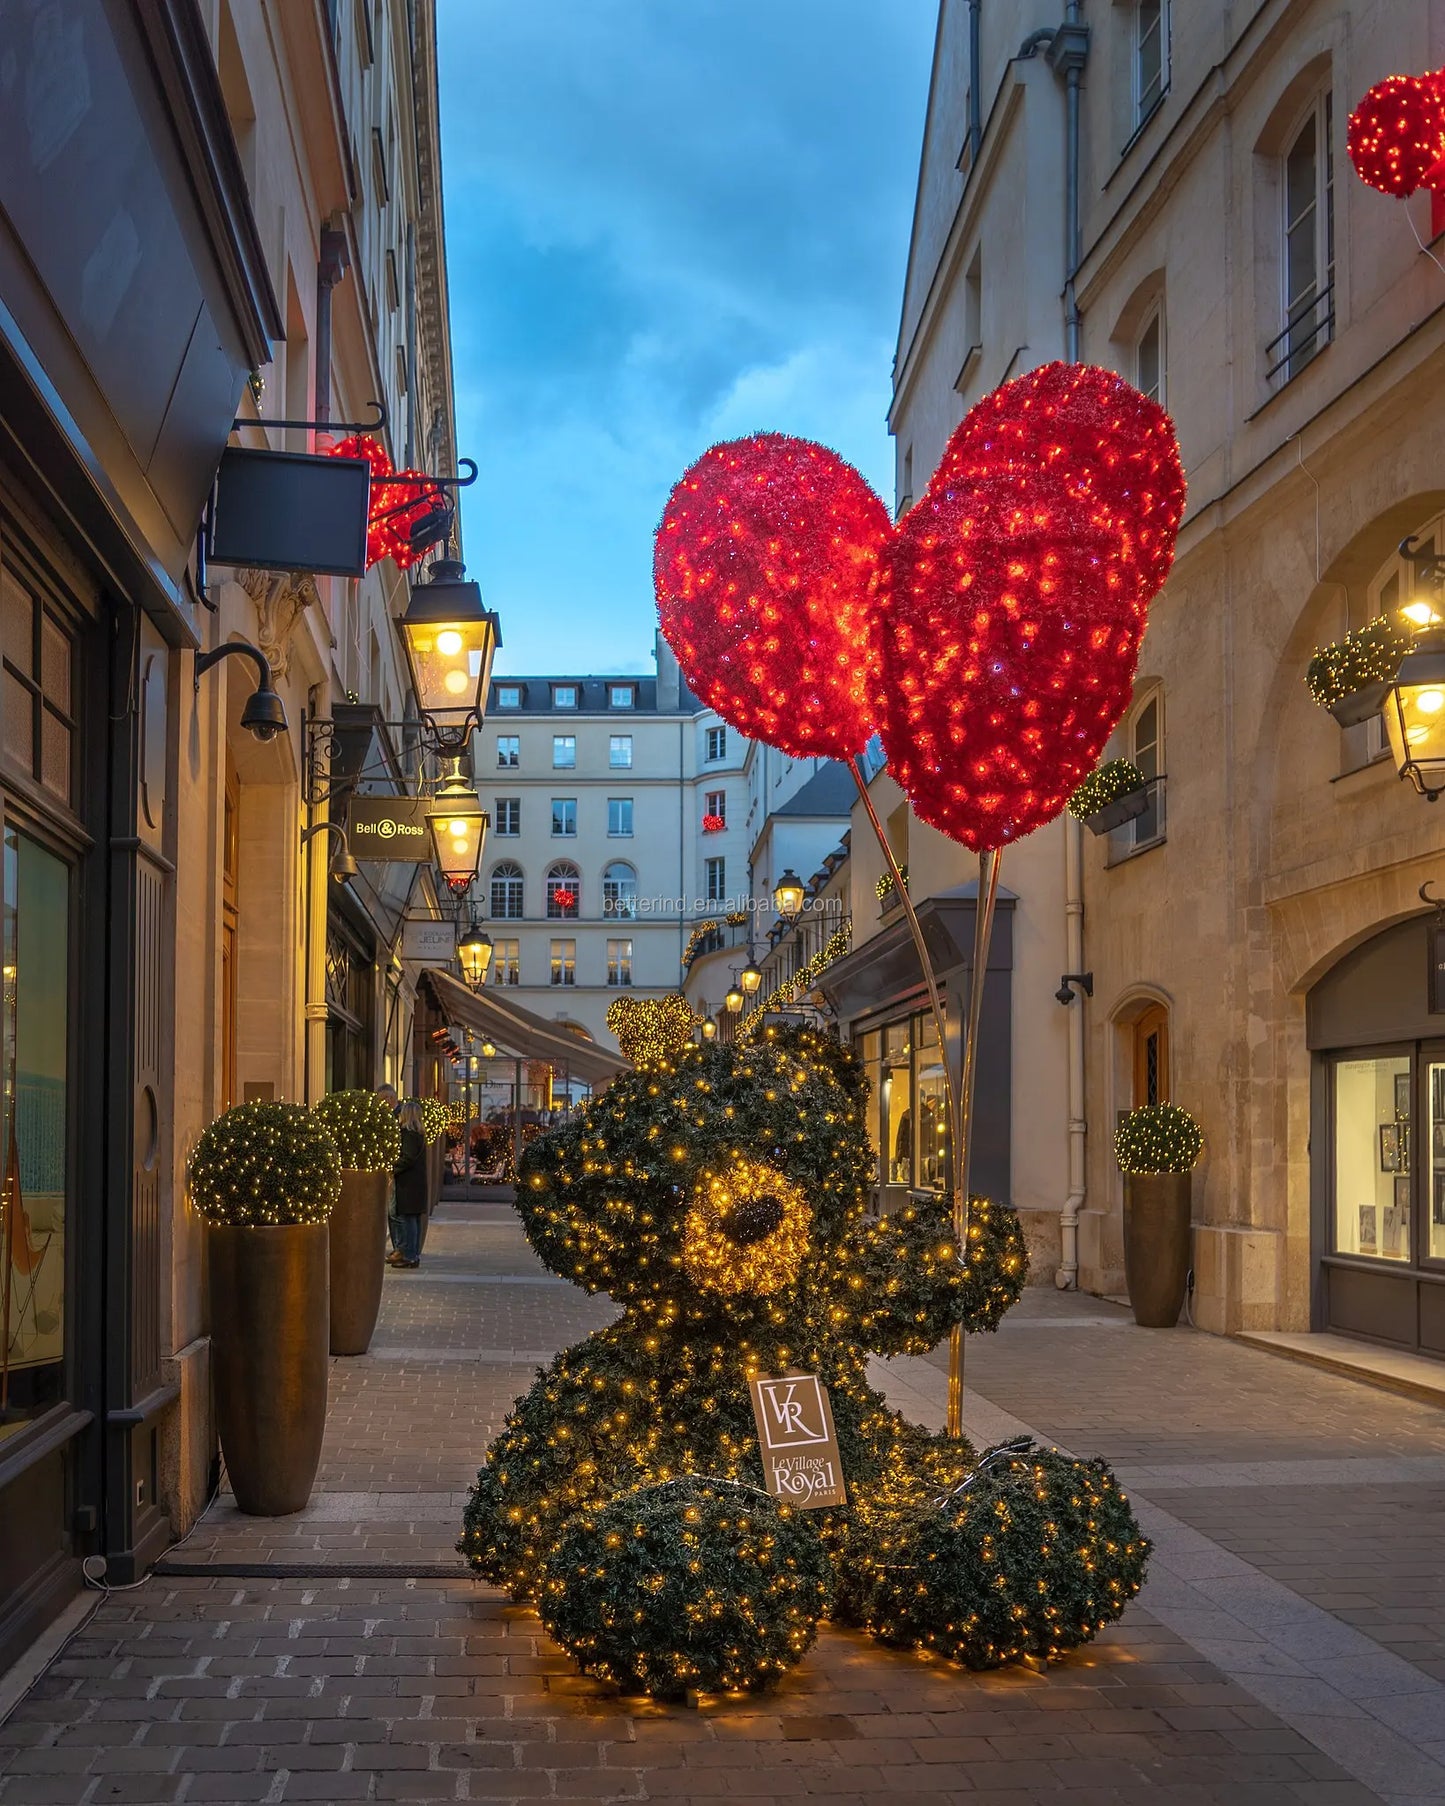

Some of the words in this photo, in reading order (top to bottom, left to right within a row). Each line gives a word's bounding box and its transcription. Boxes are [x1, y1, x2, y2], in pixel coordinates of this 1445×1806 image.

[356, 823, 377, 834] Bell
[397, 824, 424, 836] Ross
[772, 1456, 785, 1470] Le
[785, 1456, 825, 1473] Village
[772, 1462, 837, 1504] Royal
[814, 1488, 837, 1497] PARIS
